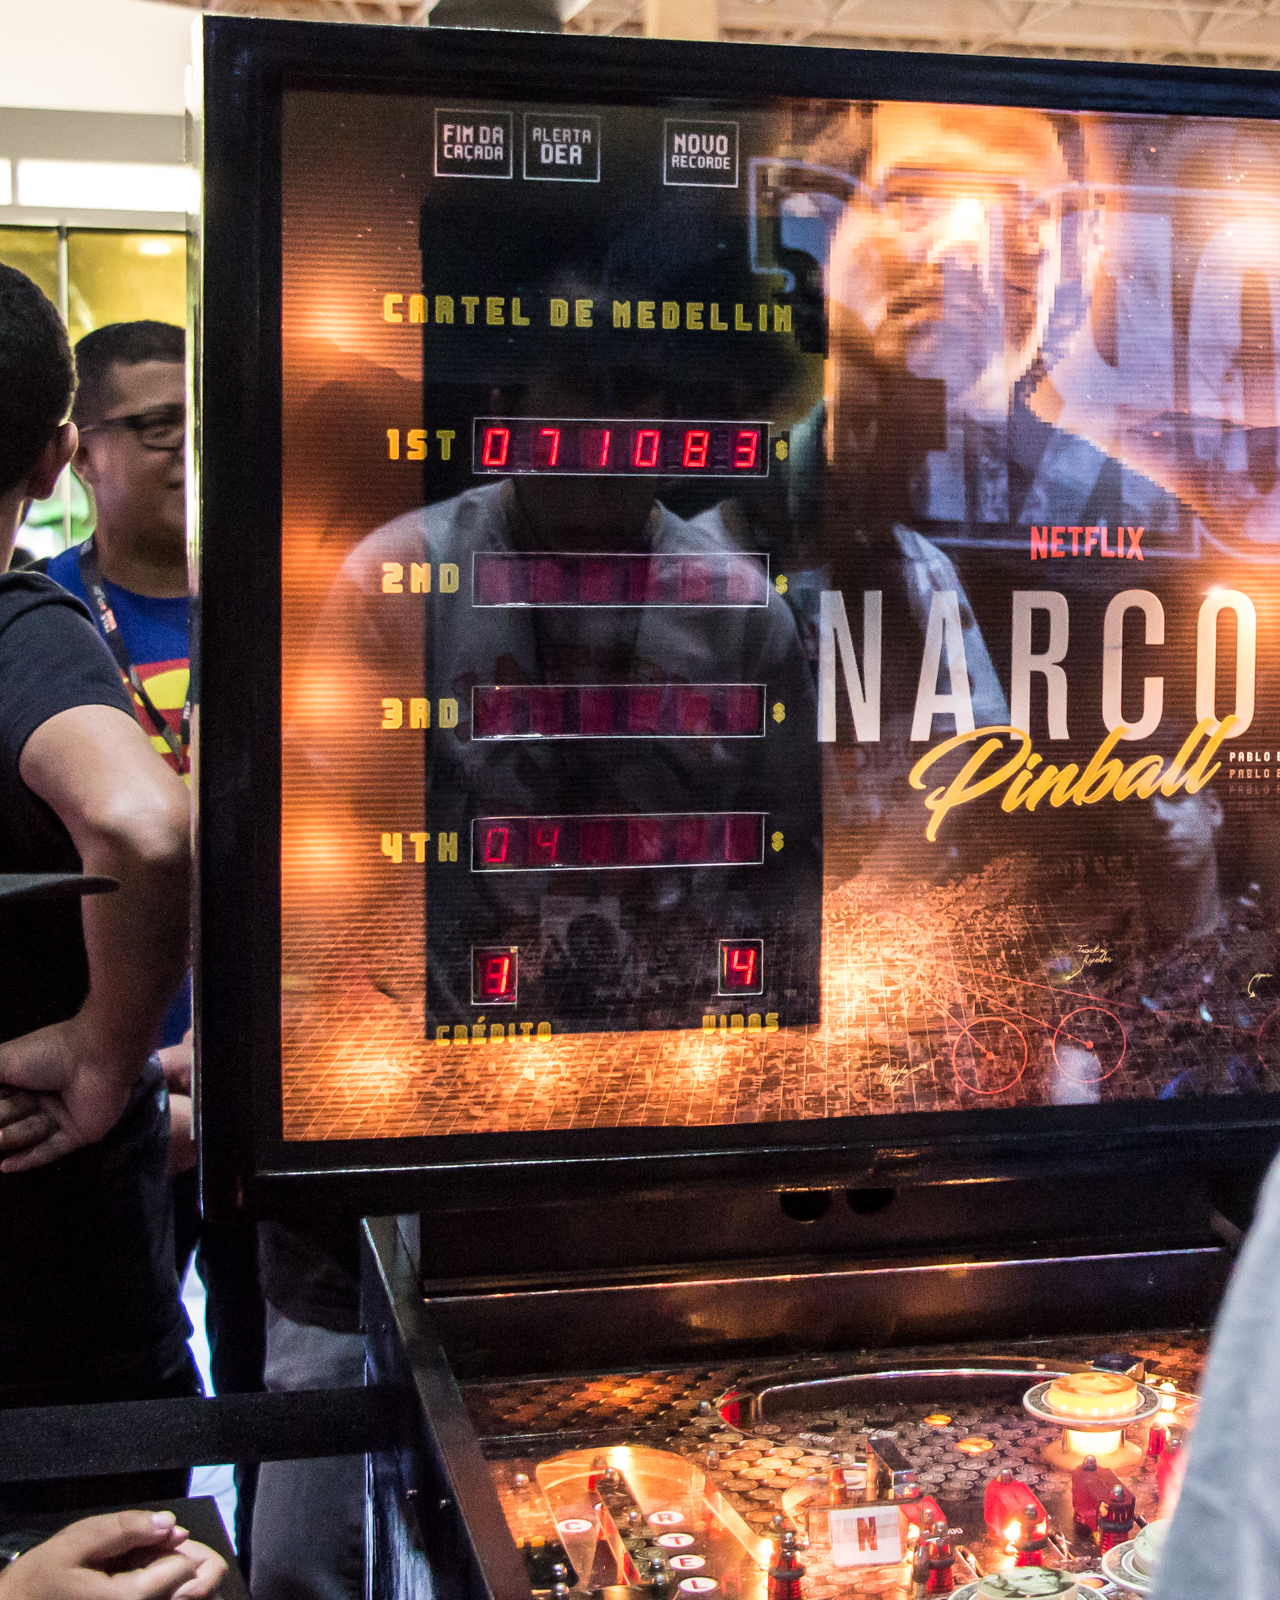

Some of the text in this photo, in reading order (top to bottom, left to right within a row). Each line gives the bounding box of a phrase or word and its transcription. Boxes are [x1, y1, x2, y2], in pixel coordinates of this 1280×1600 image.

[443, 124, 504, 144] FIM DA
[532, 127, 592, 144] ALERTA
[673, 134, 729, 156] NOVO
[443, 144, 504, 162] CAÇADA
[540, 143, 582, 165] DEA
[671, 154, 731, 170] RECORDE
[383, 293, 792, 333] CARTEL DE MEDELLIN
[386, 429, 789, 468] 1ST 071083 $
[1030, 526, 1145, 561] NETFLIX
[381, 562, 788, 595] 2ND $
[381, 697, 786, 729] 3RD $
[1229, 751, 1271, 763] PABLO
[909, 714, 1222, 842] Pinball
[1229, 768, 1271, 779] PABLO
[381, 832, 459, 864] 4TH
[771, 831, 785, 852] $
[731, 949, 757, 985] 4
[435, 1016, 553, 1046] CRÉDITO
[702, 1012, 779, 1034] VIDAS
[563, 1521, 583, 1531] C
[656, 1512, 674, 1523] R
[667, 1535, 685, 1546] T
[856, 1516, 878, 1552] N
[679, 1556, 696, 1568] E
[691, 1579, 708, 1589] L
